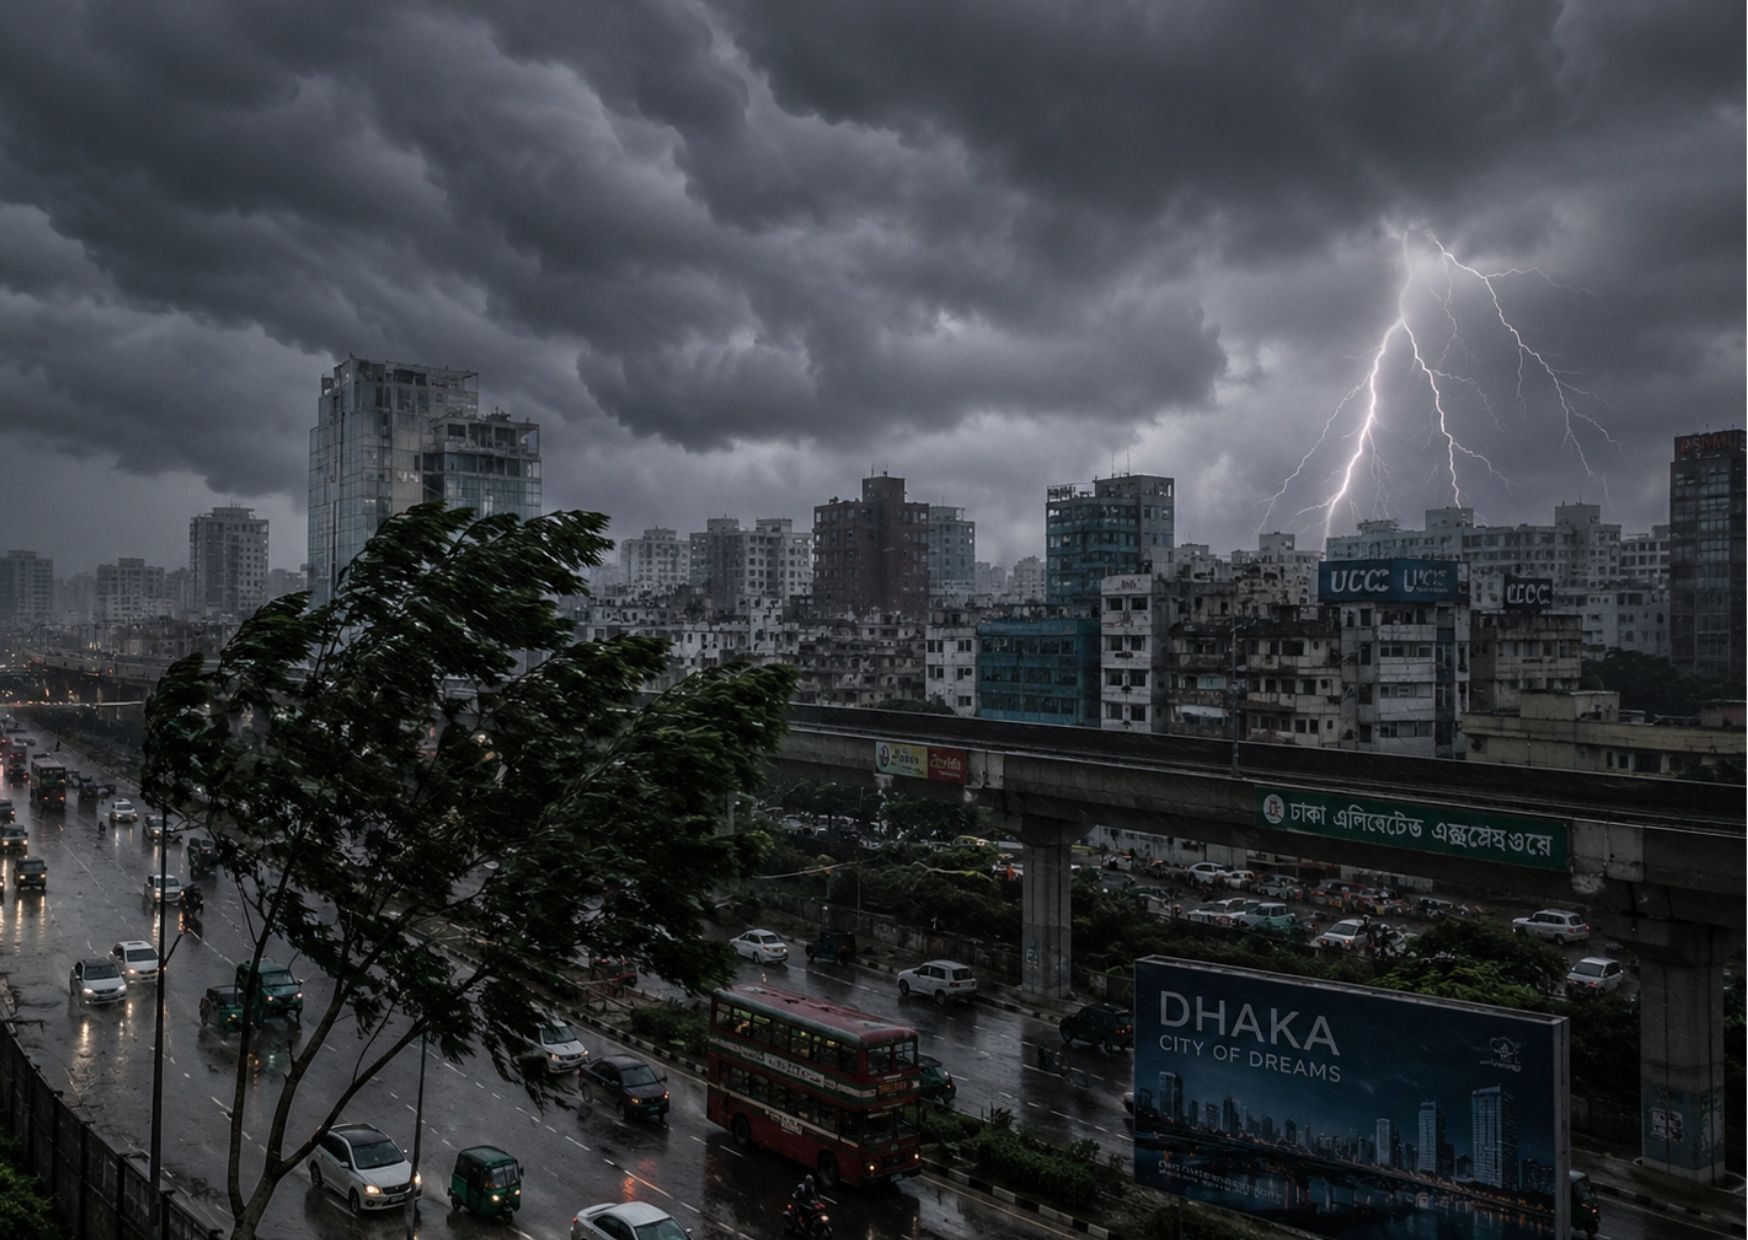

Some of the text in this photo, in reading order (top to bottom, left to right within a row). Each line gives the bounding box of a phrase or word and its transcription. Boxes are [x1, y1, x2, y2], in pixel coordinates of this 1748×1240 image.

[1289, 801, 1327, 825] ঢাকা
[1159, 990, 1341, 1057] DHAKA
[1159, 1034, 1341, 1083] CITY OF DREAMS
